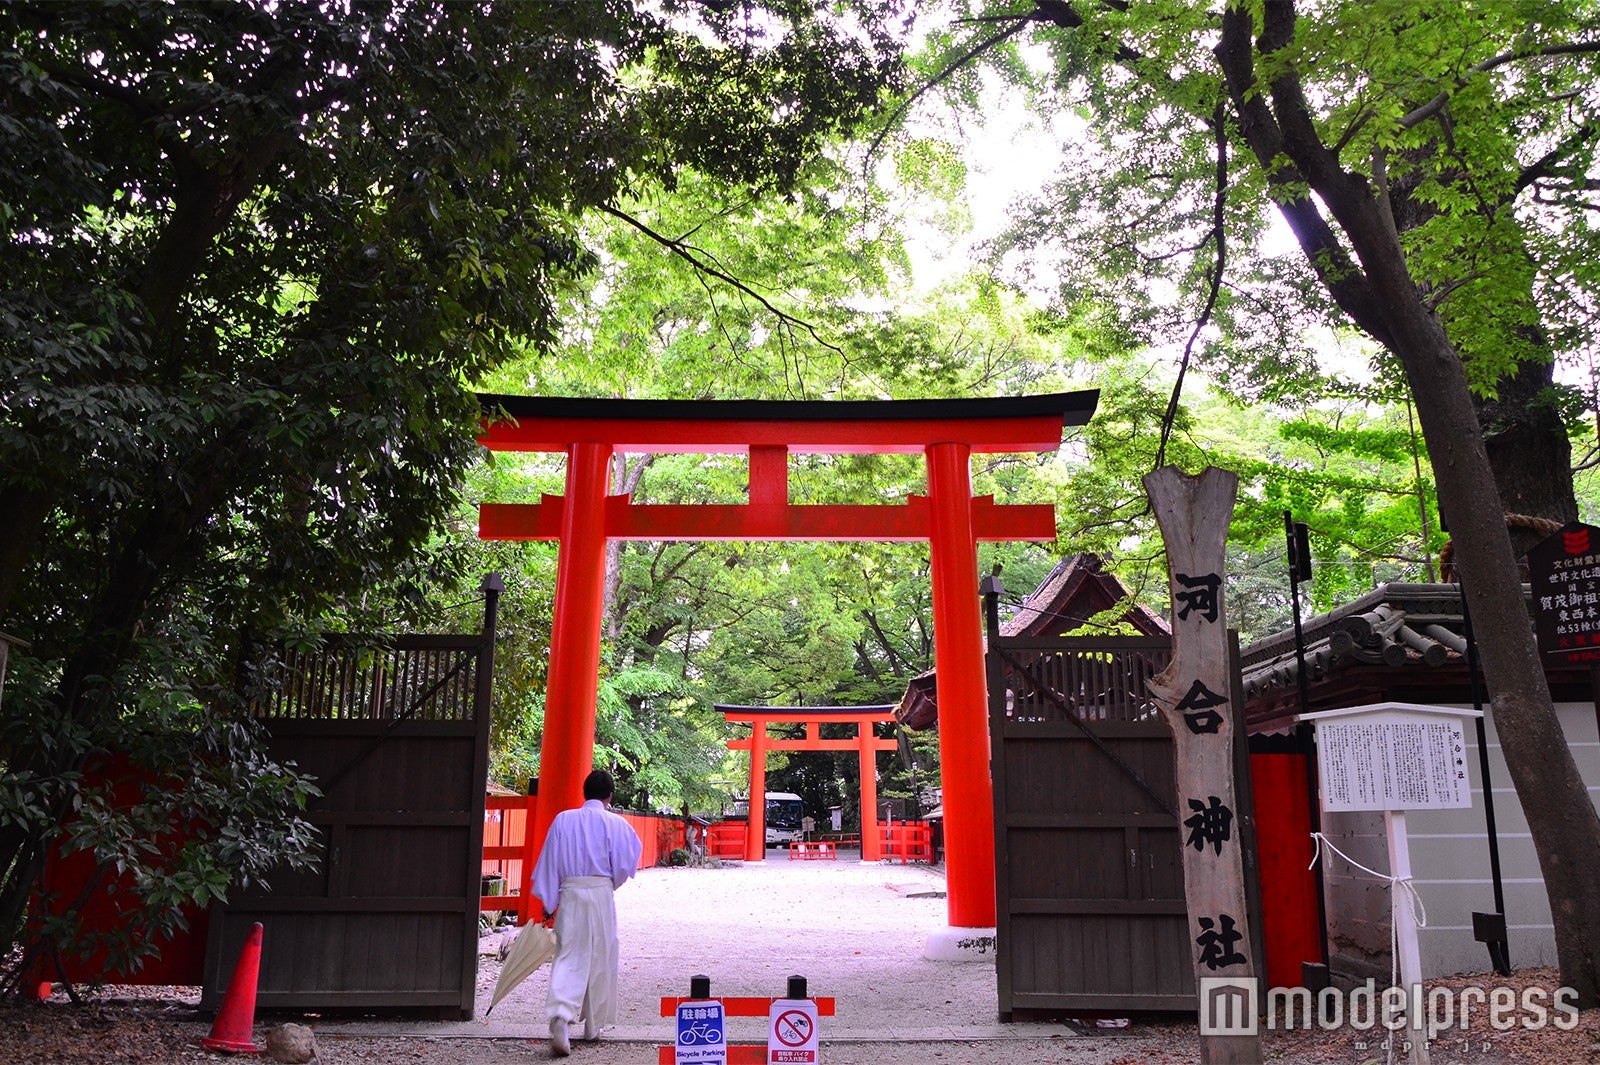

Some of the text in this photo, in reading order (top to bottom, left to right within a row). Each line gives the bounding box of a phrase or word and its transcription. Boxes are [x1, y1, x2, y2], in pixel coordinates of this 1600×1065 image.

[1540, 592, 1600, 610] 賀茂御祖
[1559, 606, 1598, 622] 東西本
[1175, 572, 1248, 971] 河合神社
[682, 1007, 719, 1020] 駐輪場
[677, 1051, 700, 1059] Bicycle
